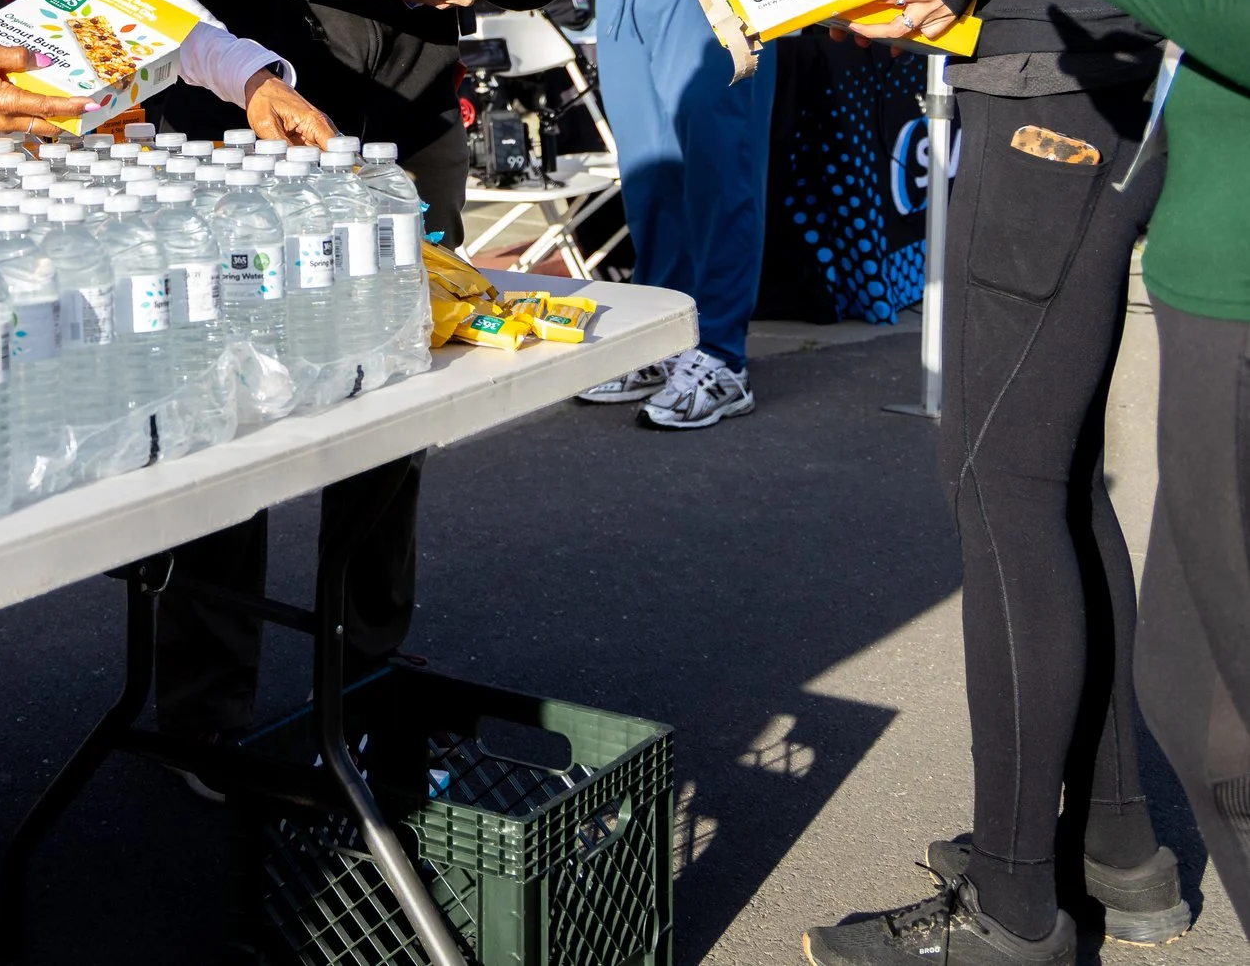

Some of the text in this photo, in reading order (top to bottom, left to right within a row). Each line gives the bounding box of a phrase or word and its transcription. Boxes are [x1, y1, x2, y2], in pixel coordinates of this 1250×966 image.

[33, 37, 70, 57] Butter
[232, 256, 248, 266] 365
[475, 318, 501, 330] 365
